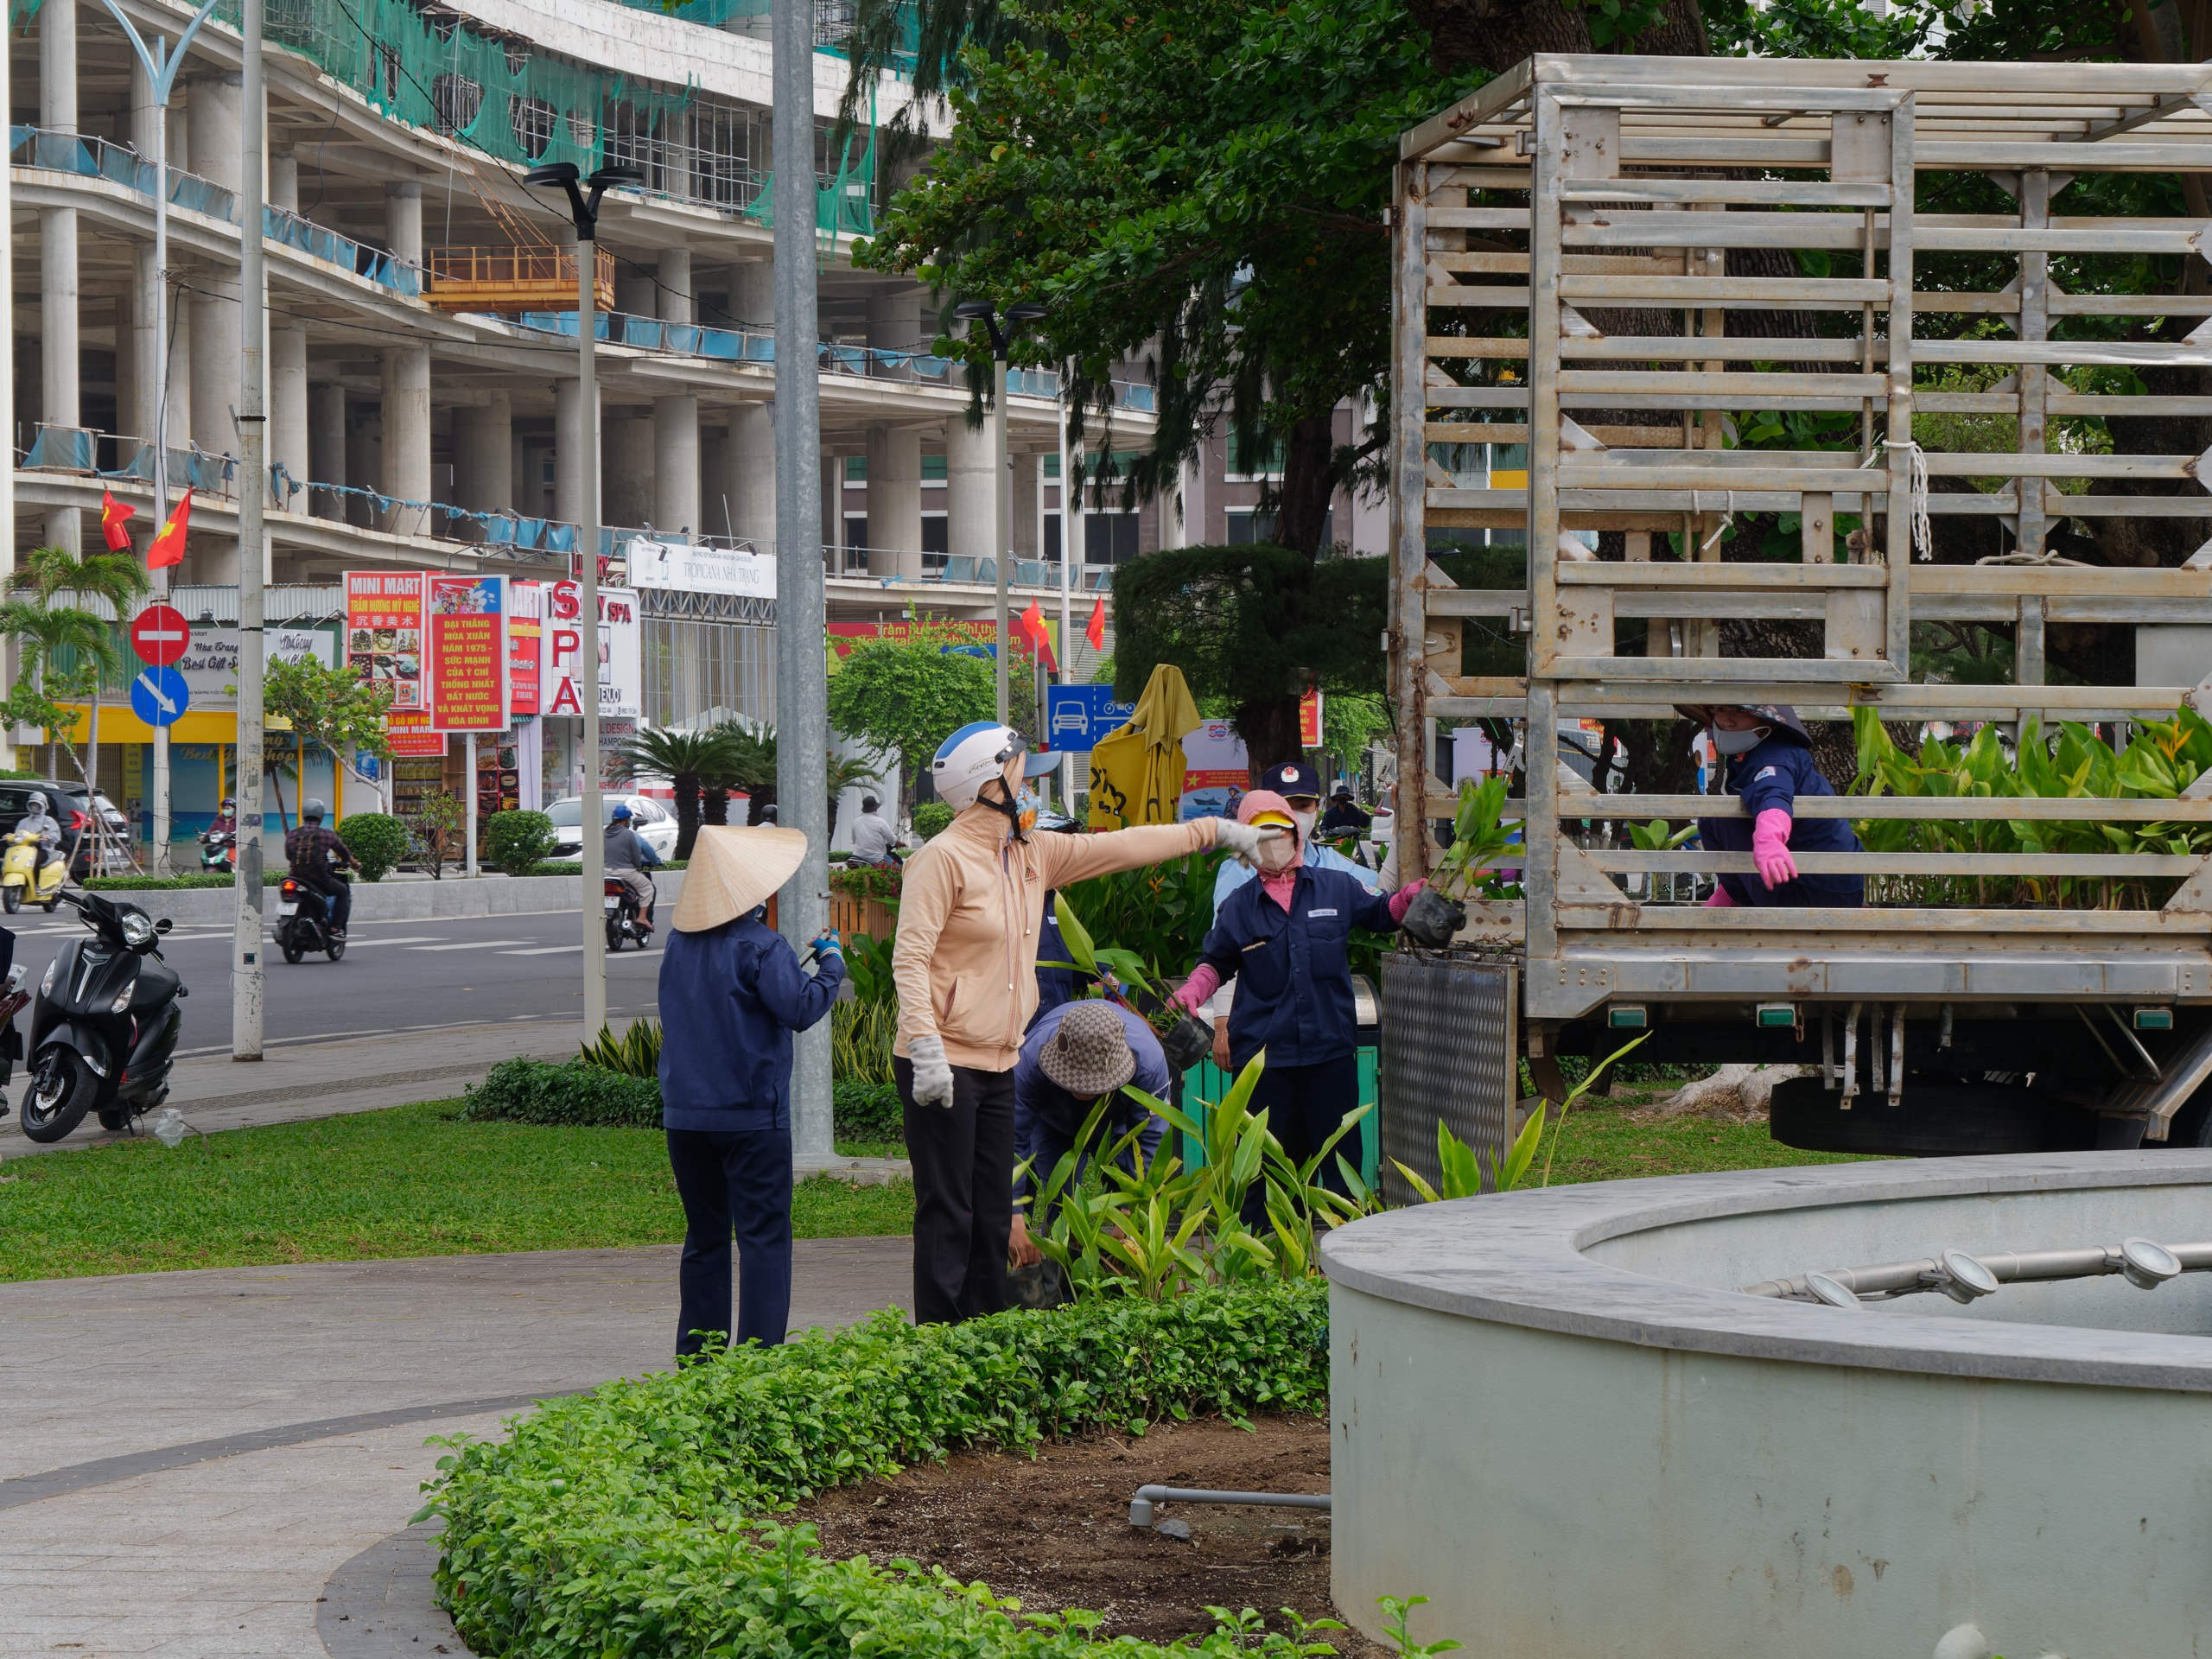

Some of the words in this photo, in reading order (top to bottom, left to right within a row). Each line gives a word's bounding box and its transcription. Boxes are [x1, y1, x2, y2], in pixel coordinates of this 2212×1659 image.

[684, 562, 721, 582] TROPICANA
[351, 577, 381, 594] MINI
[385, 577, 420, 594] MART
[607, 601, 632, 623] SPA
[467, 631, 490, 640] XUÂN
[466, 644, 486, 652] 1975
[182, 656, 205, 671] Best
[208, 656, 225, 671] Gift
[389, 725, 409, 734] MINI
[410, 725, 429, 734] MAR
[598, 736, 626, 747] HAMPOO
